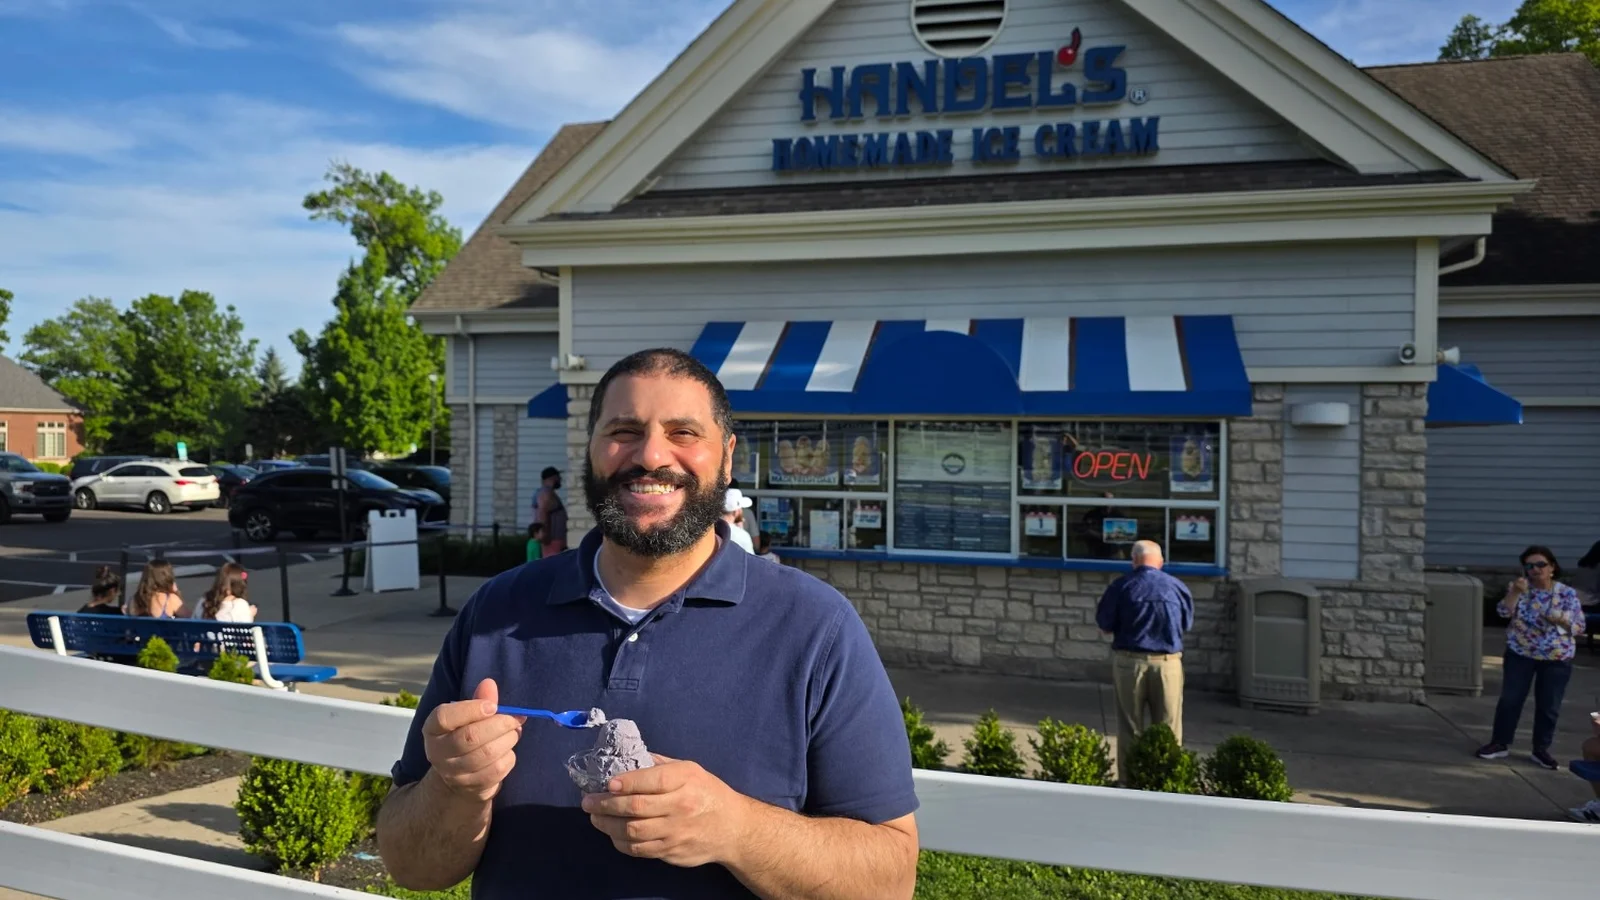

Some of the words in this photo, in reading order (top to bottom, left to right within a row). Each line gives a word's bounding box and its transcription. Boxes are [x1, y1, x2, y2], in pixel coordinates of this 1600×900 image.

[799, 30, 1126, 121] HANDEL'S
[771, 130, 953, 171] HOMEMADE
[972, 126, 1020, 162] ICE
[1034, 116, 1160, 159] CREAM
[1073, 451, 1151, 480] OPEN
[1038, 518, 1043, 529] 1
[1189, 522, 1198, 534] 2
